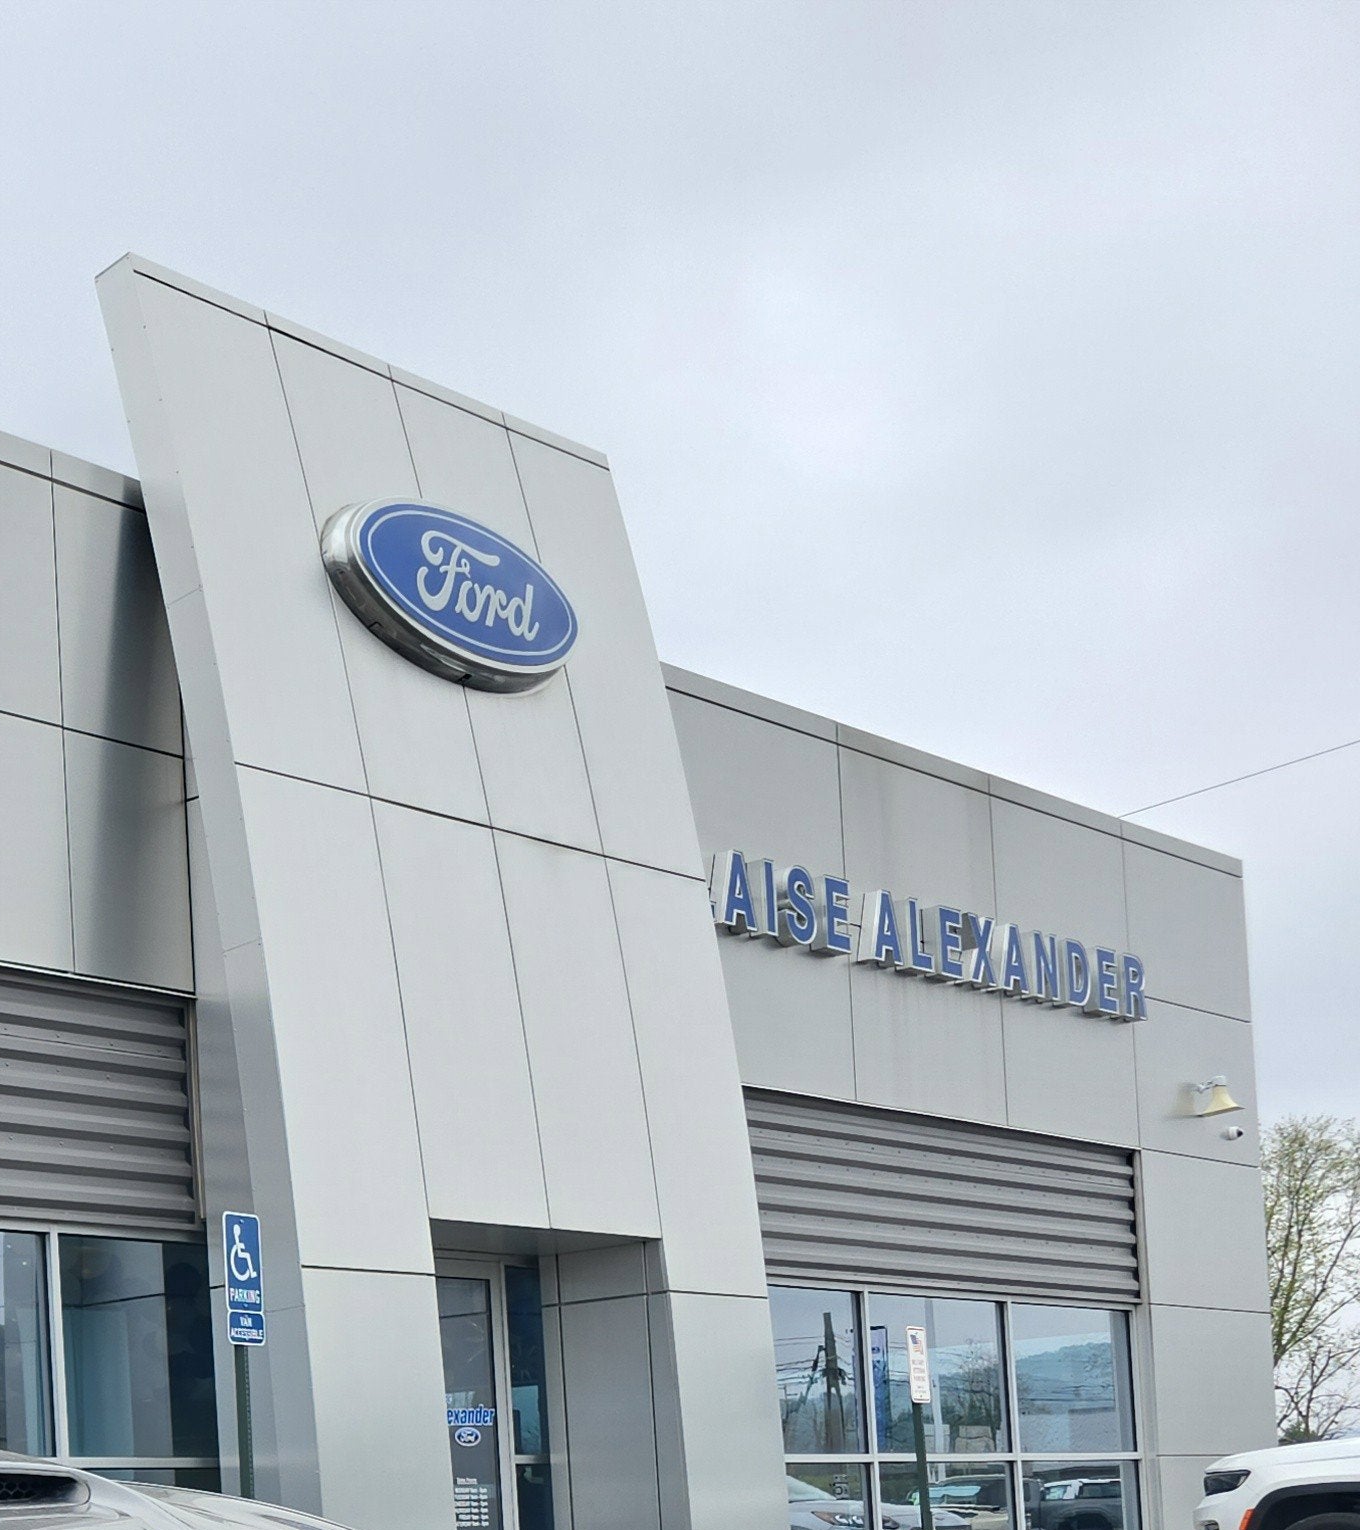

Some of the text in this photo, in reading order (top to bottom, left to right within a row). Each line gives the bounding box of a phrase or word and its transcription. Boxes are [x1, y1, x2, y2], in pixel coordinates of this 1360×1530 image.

[417, 530, 540, 641] Ford
[710, 849, 1147, 1021] AISE ALEXANDER
[230, 1287, 261, 1304] PARKING
[240, 1316, 253, 1328] VAN
